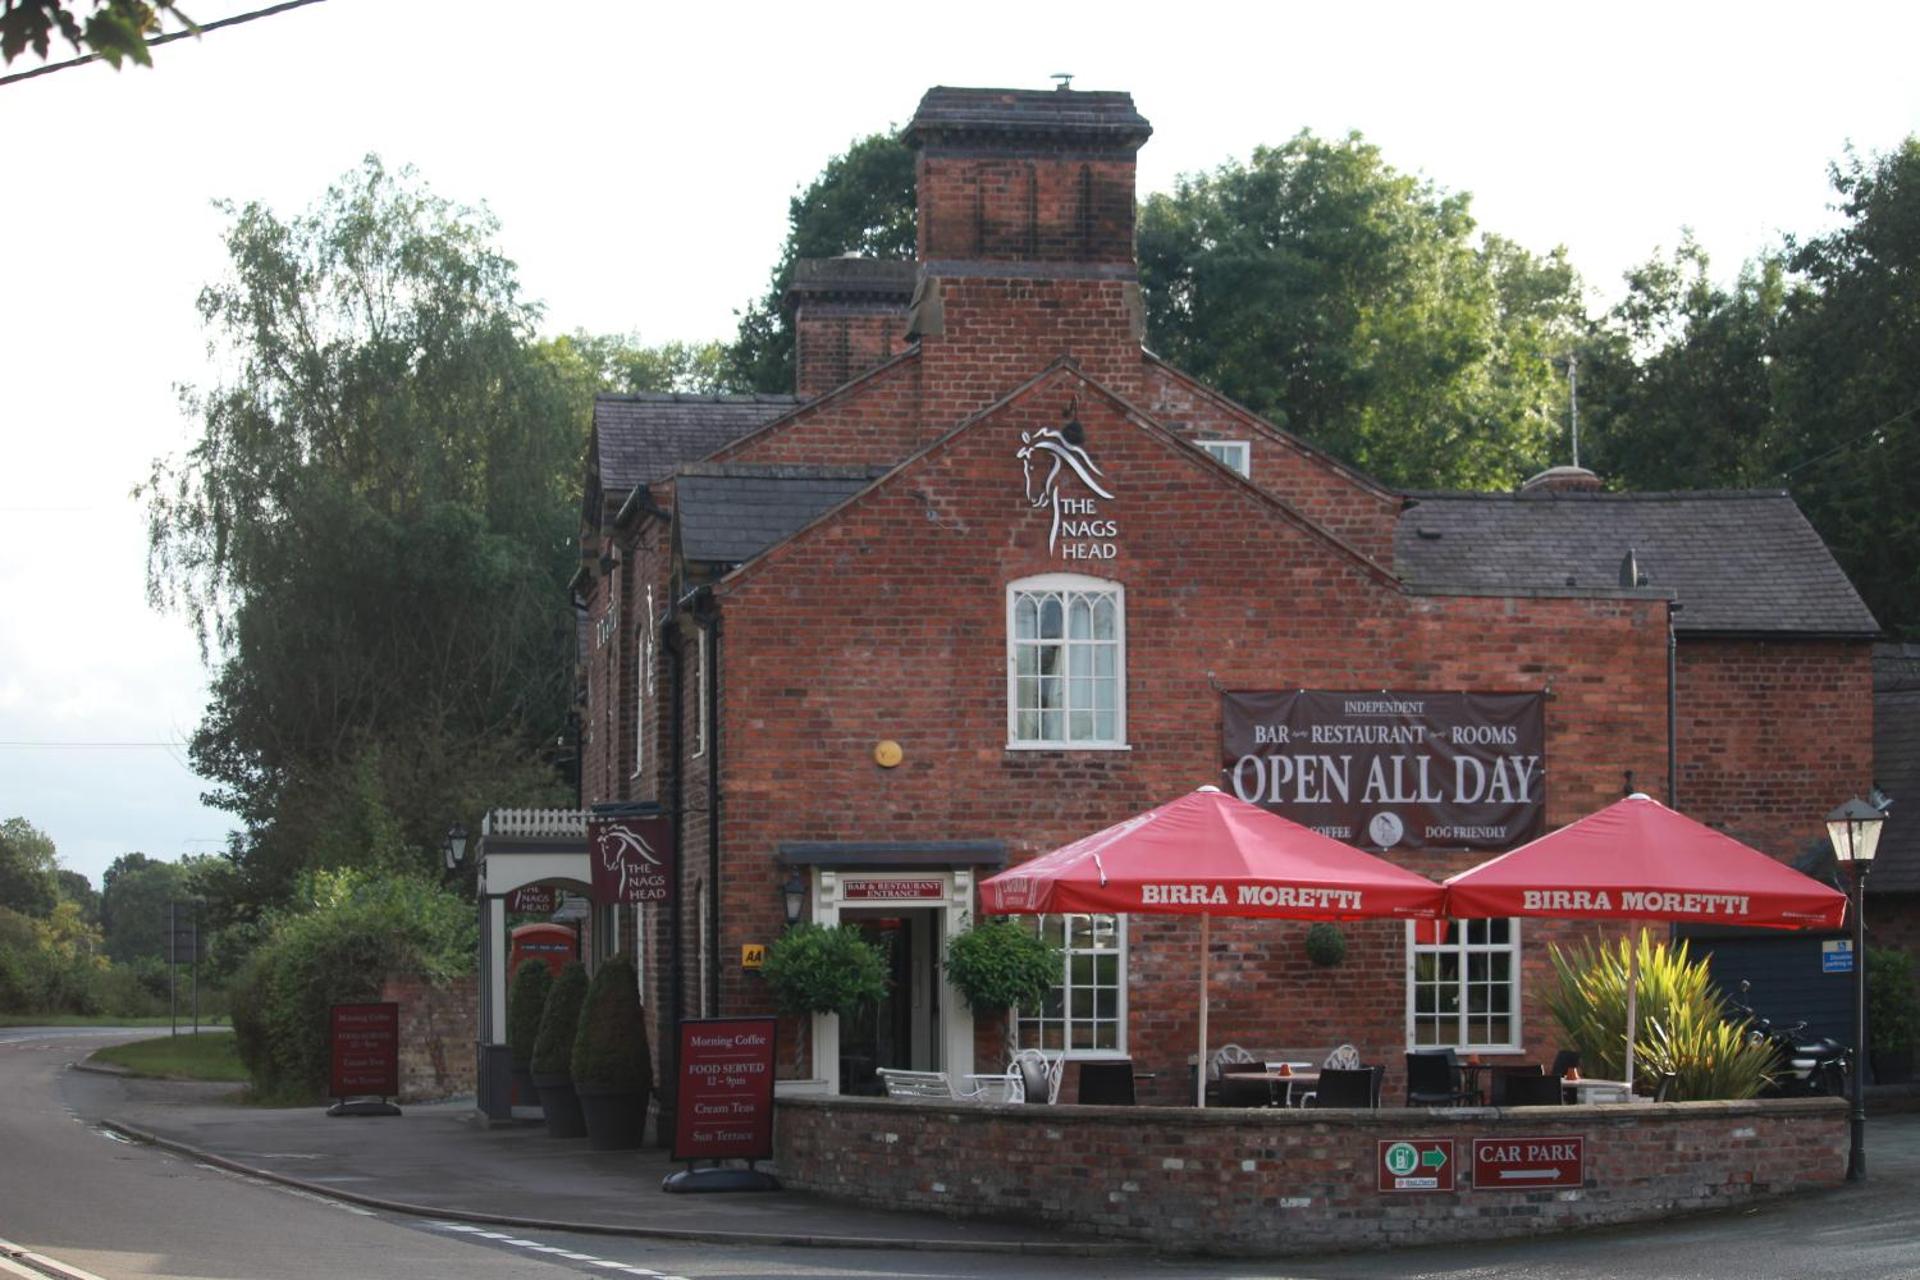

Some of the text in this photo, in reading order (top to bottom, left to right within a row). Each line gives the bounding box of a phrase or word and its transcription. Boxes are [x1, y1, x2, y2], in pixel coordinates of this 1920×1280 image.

[1061, 498, 1096, 514] THE
[1062, 520, 1117, 537] NAGS
[1062, 543, 1117, 559] HEAD
[1344, 701, 1424, 714] INDEPENDENT
[1255, 725, 1517, 745] BAR RESTAURANT ROOMS
[1233, 755, 1538, 804] OPEN ALL DAY
[1425, 826, 1451, 839] DOG
[1453, 826, 1507, 840] FRIENDLY
[627, 864, 651, 874] THE
[629, 875, 665, 887] NAGS
[847, 882, 866, 890] BAR
[877, 881, 940, 890] RESTAURANT
[630, 889, 666, 900] HEAD
[867, 889, 920, 898] ENTRANCE
[1142, 885, 1362, 909] BIRRA MORETTI
[1523, 890, 1749, 915] BIRRA MORETTI
[690, 1034, 766, 1049] Morning Coffee
[688, 1063, 765, 1075] FOOD SERVED
[694, 1103, 729, 1114] Cream
[1479, 1144, 1578, 1162] CAR PARK
